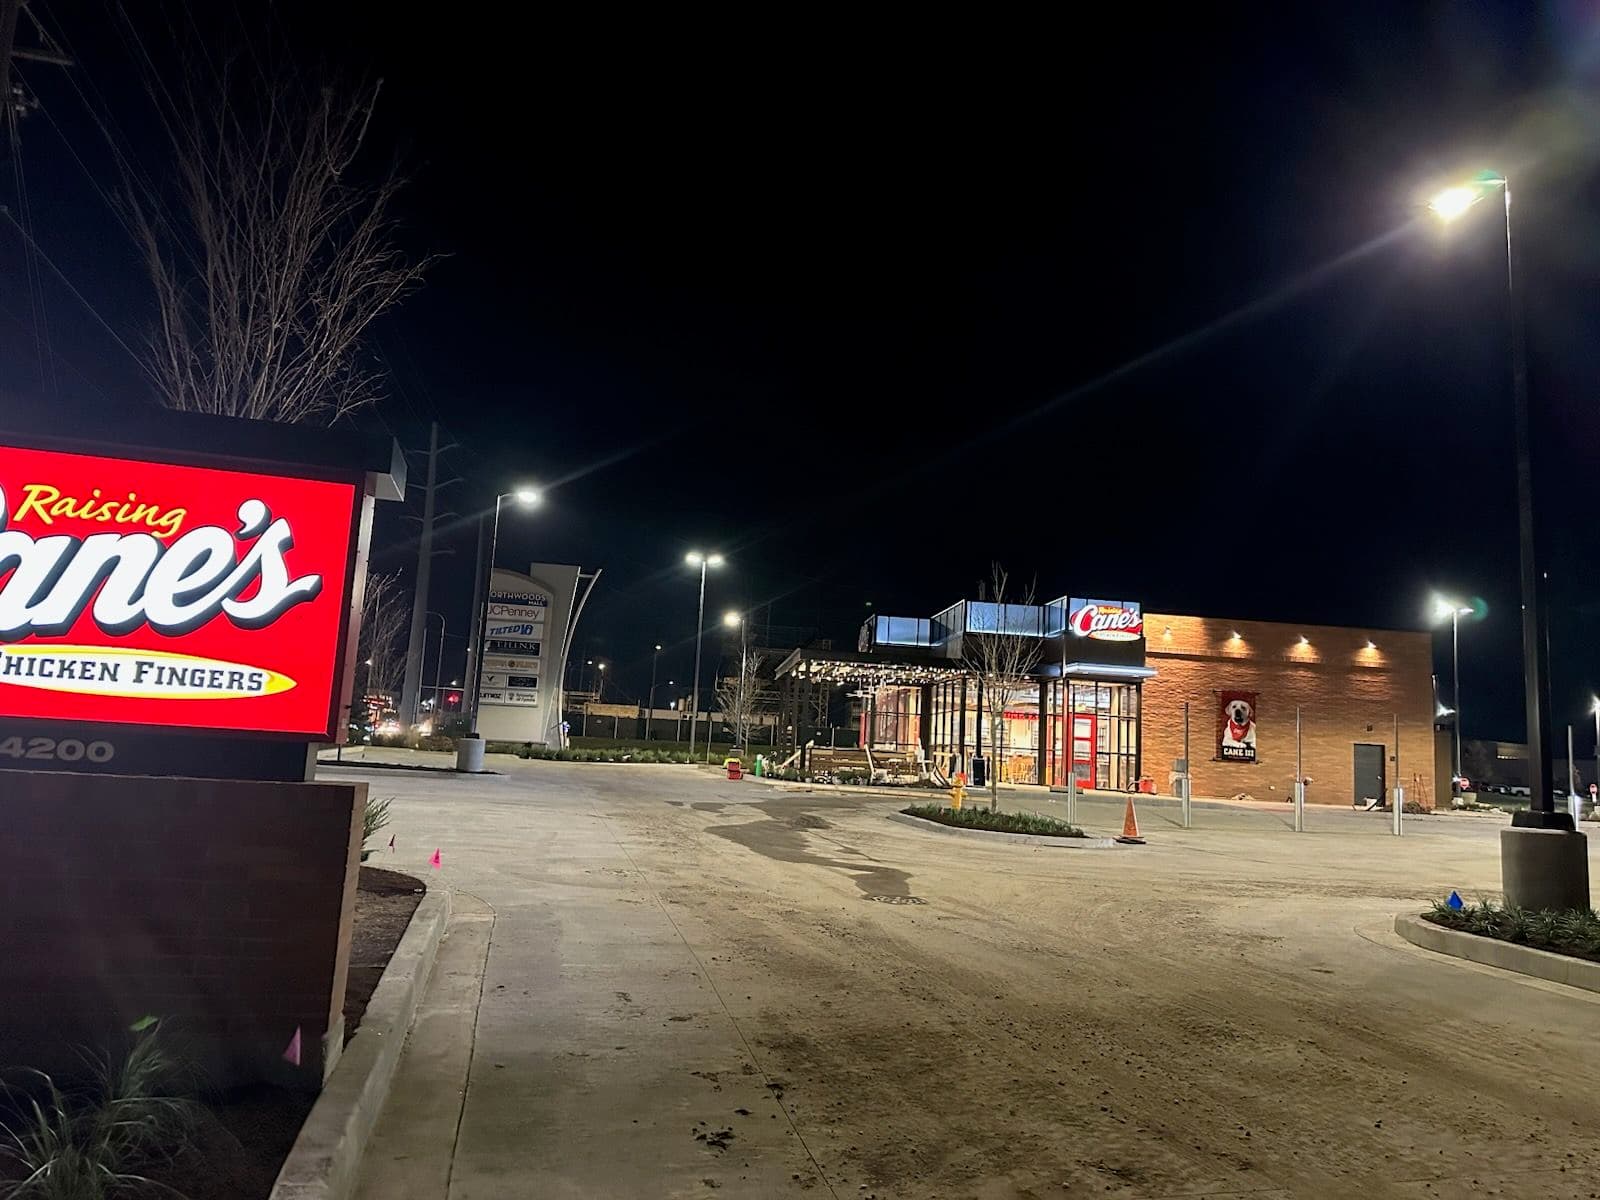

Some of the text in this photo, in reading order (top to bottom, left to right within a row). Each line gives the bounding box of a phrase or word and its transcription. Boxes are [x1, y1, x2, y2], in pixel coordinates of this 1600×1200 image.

[12, 483, 187, 539] Raising
[0, 483, 323, 638] ane's
[489, 591, 546, 602] ORTHWOODS
[1073, 604, 1143, 637] Cane's
[0, 652, 264, 693] HICKEN FINGERS
[0, 736, 115, 763] 4200
[1223, 747, 1244, 757] CANE
